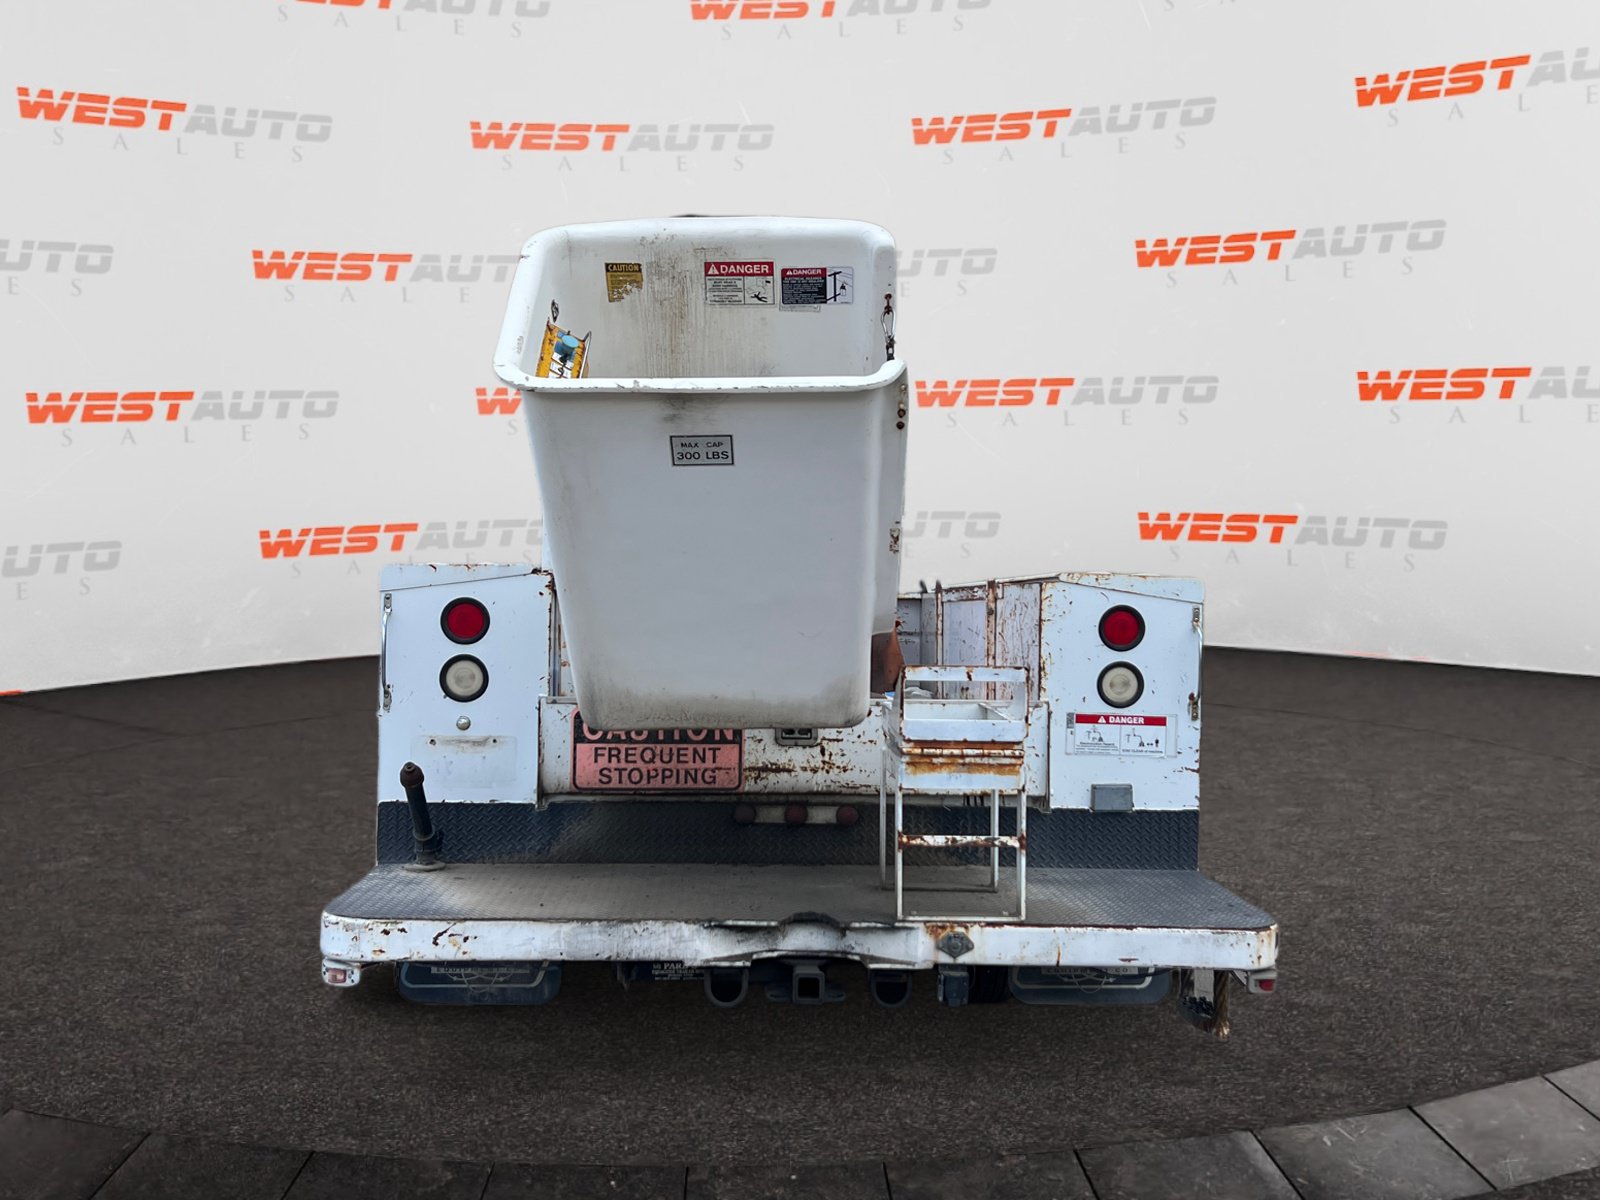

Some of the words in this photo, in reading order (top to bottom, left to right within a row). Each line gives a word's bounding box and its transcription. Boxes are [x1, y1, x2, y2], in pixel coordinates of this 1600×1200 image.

[53, 127, 304, 163] SALES
[944, 132, 1187, 165] SALES
[502, 153, 744, 172] SALES
[607, 263, 639, 272] CAUTION
[719, 264, 769, 274] DANGER
[1166, 255, 1414, 288] SALES
[945, 407, 1190, 427] SALES
[61, 422, 310, 447] SALES
[676, 450, 701, 460] 300
[705, 450, 729, 460] LBS
[1171, 545, 1416, 572] SALES
[1108, 716, 1145, 725] DANGER
[593, 747, 721, 765] FREQUENT
[598, 767, 718, 785] STOPPING
